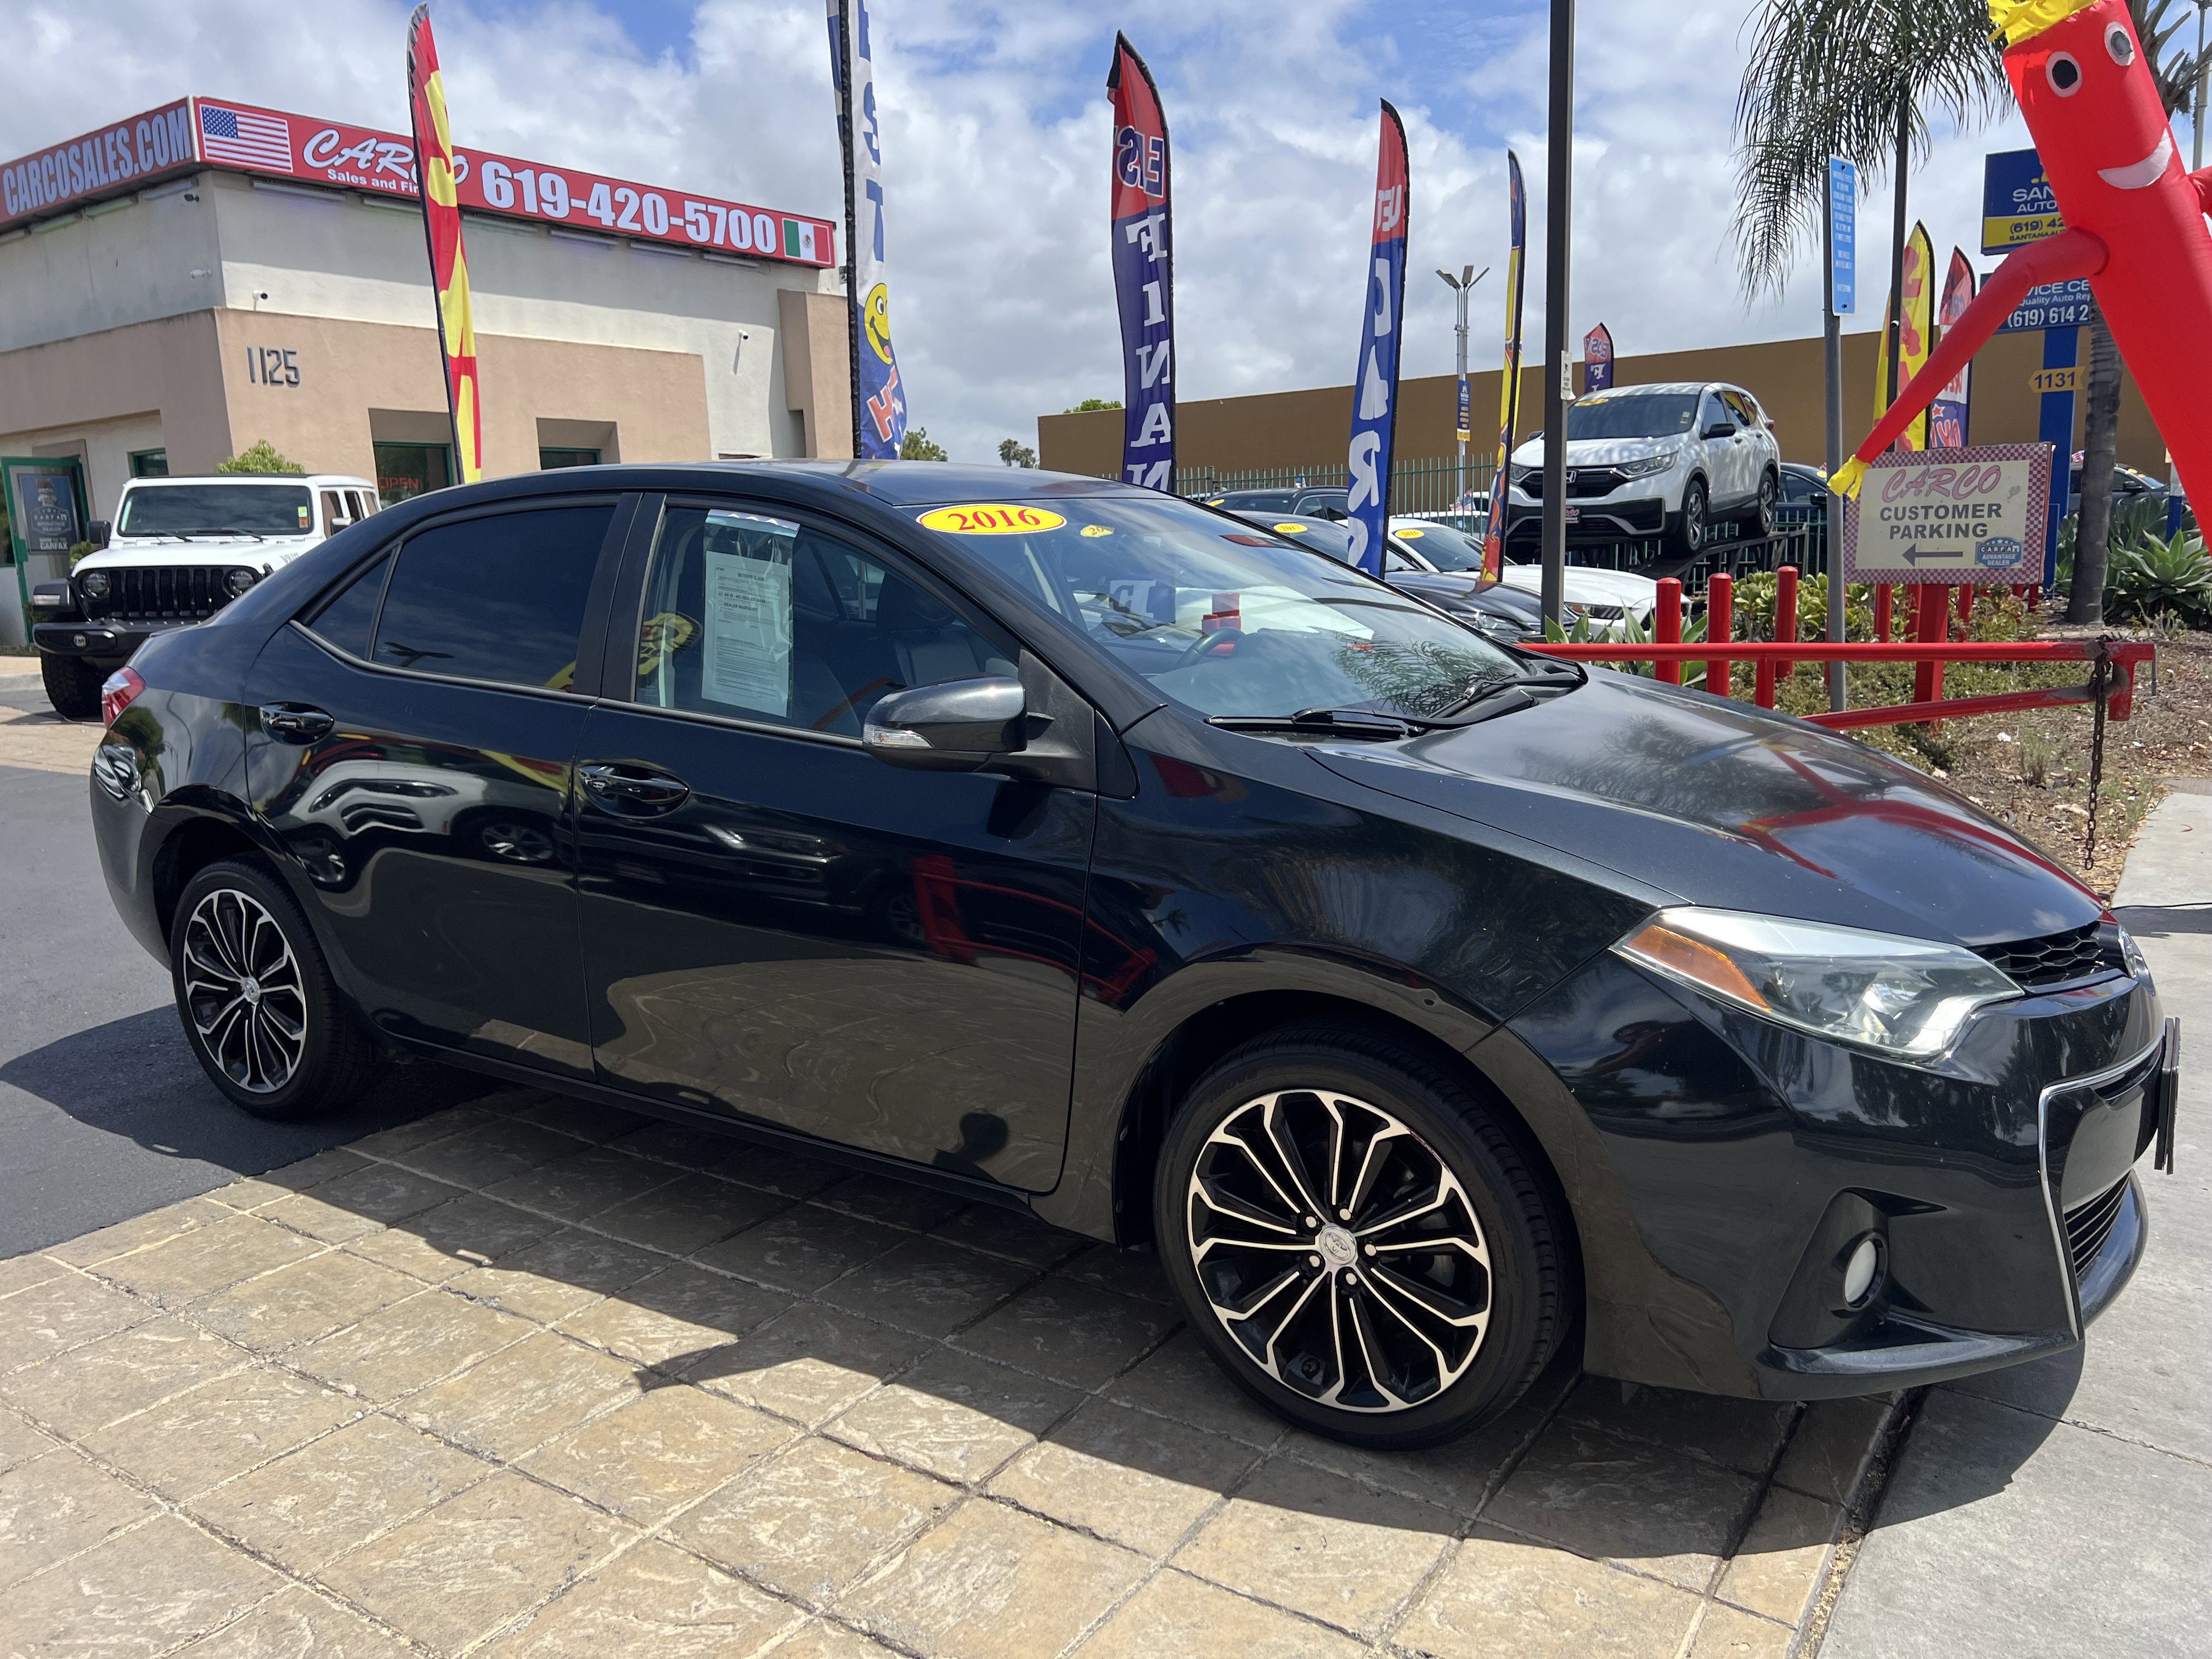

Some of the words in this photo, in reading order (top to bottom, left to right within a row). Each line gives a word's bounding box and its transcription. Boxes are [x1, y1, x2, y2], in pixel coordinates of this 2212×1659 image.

[3, 106, 192, 216] CARCOSALES.COM
[302, 128, 470, 185] CARO
[328, 168, 368, 185] Sales
[371, 178, 397, 190] and
[481, 160, 777, 253] 619-420-5700
[2017, 200, 2058, 213] AUTO
[2010, 220, 2043, 234] (619)
[2052, 294, 2074, 303] Auto
[2007, 308, 2045, 328] (619)
[2049, 305, 2075, 324] 614
[2079, 304, 2089, 321] 2
[247, 346, 300, 387] 1125
[2034, 371, 2075, 389] 1131
[379, 477, 420, 490] OPEN
[1882, 464, 2001, 503] CARCO
[948, 509, 1041, 531] 2016
[1880, 503, 2002, 521] CUSTOMER
[1889, 523, 1988, 539] PARKING
